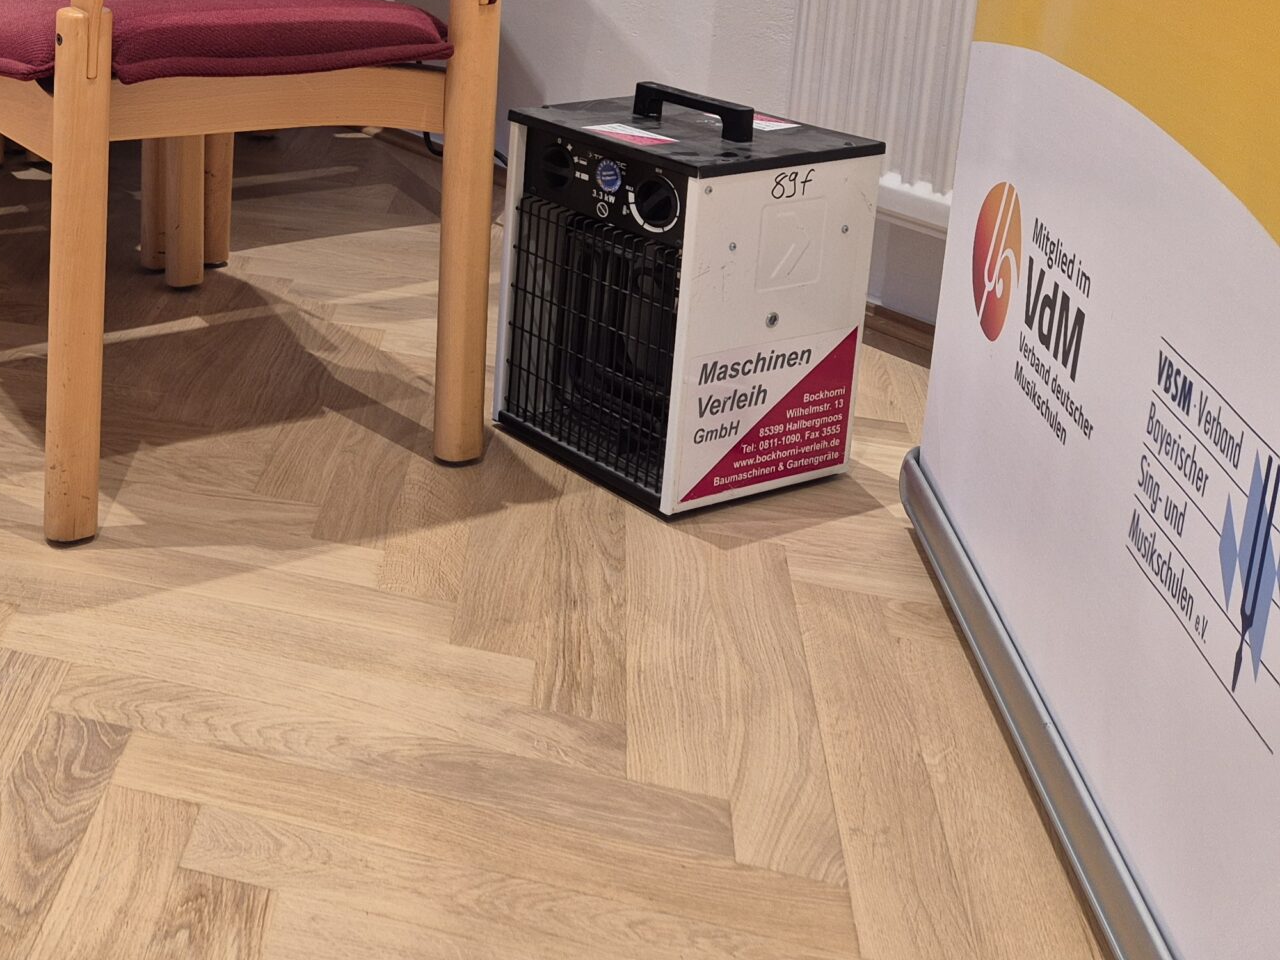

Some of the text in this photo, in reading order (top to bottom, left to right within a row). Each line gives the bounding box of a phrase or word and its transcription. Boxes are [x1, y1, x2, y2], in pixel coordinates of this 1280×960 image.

[604, 192, 616, 204] kW
[1032, 217, 1091, 299] Mitglied im
[1024, 255, 1086, 383] VdM
[698, 348, 812, 386] Maschinen
[1018, 330, 1094, 441] Verband deutscher
[697, 384, 768, 419] Verleih
[786, 399, 844, 419] Wilhelmstr. 13
[803, 386, 846, 403] Bockhorni
[1014, 360, 1067, 446] Musikschulen
[1157, 349, 1245, 470] VBSM Verband
[693, 420, 741, 445] GmbH
[742, 442, 757, 455] Tel:
[804, 429, 820, 441] Fax
[821, 424, 841, 438] 3555
[758, 413, 843, 438] 85399 Hallbergmoos
[733, 438, 841, 469] www.bockhorni-verleih.de
[1146, 400, 1209, 498] Bayerischer
[713, 451, 839, 487] Baumaschinen & Gartengeräte
[1137, 454, 1188, 538] Sing- und
[1128, 507, 1209, 644] Musikschulen e.V.
